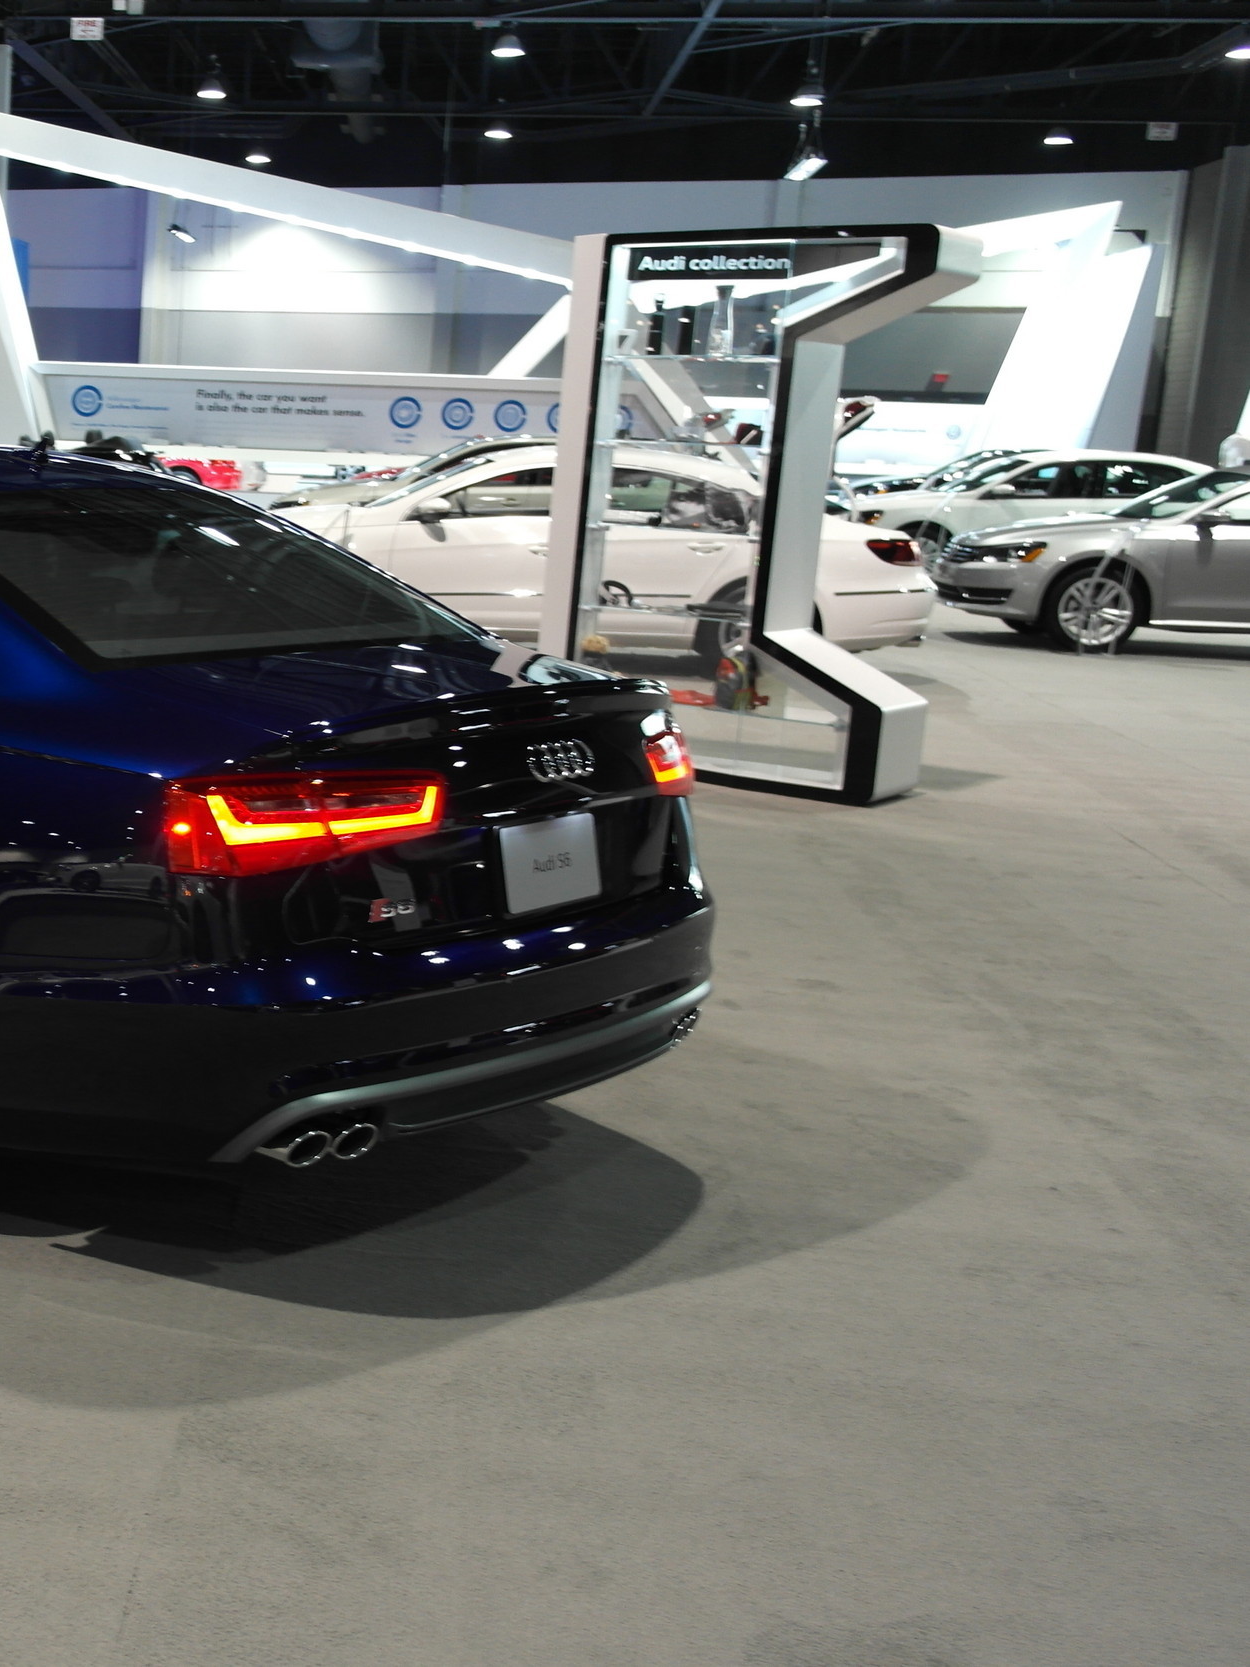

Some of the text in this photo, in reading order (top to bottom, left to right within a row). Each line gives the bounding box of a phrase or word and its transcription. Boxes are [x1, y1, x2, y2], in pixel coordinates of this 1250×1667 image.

[638, 255, 792, 271] Audi collection
[237, 390, 253, 401] the
[256, 393, 273, 402] car
[276, 393, 295, 403] you
[298, 394, 328, 403] want
[195, 402, 366, 417] is also the car that makes sense.
[533, 851, 573, 872] Audi S6
